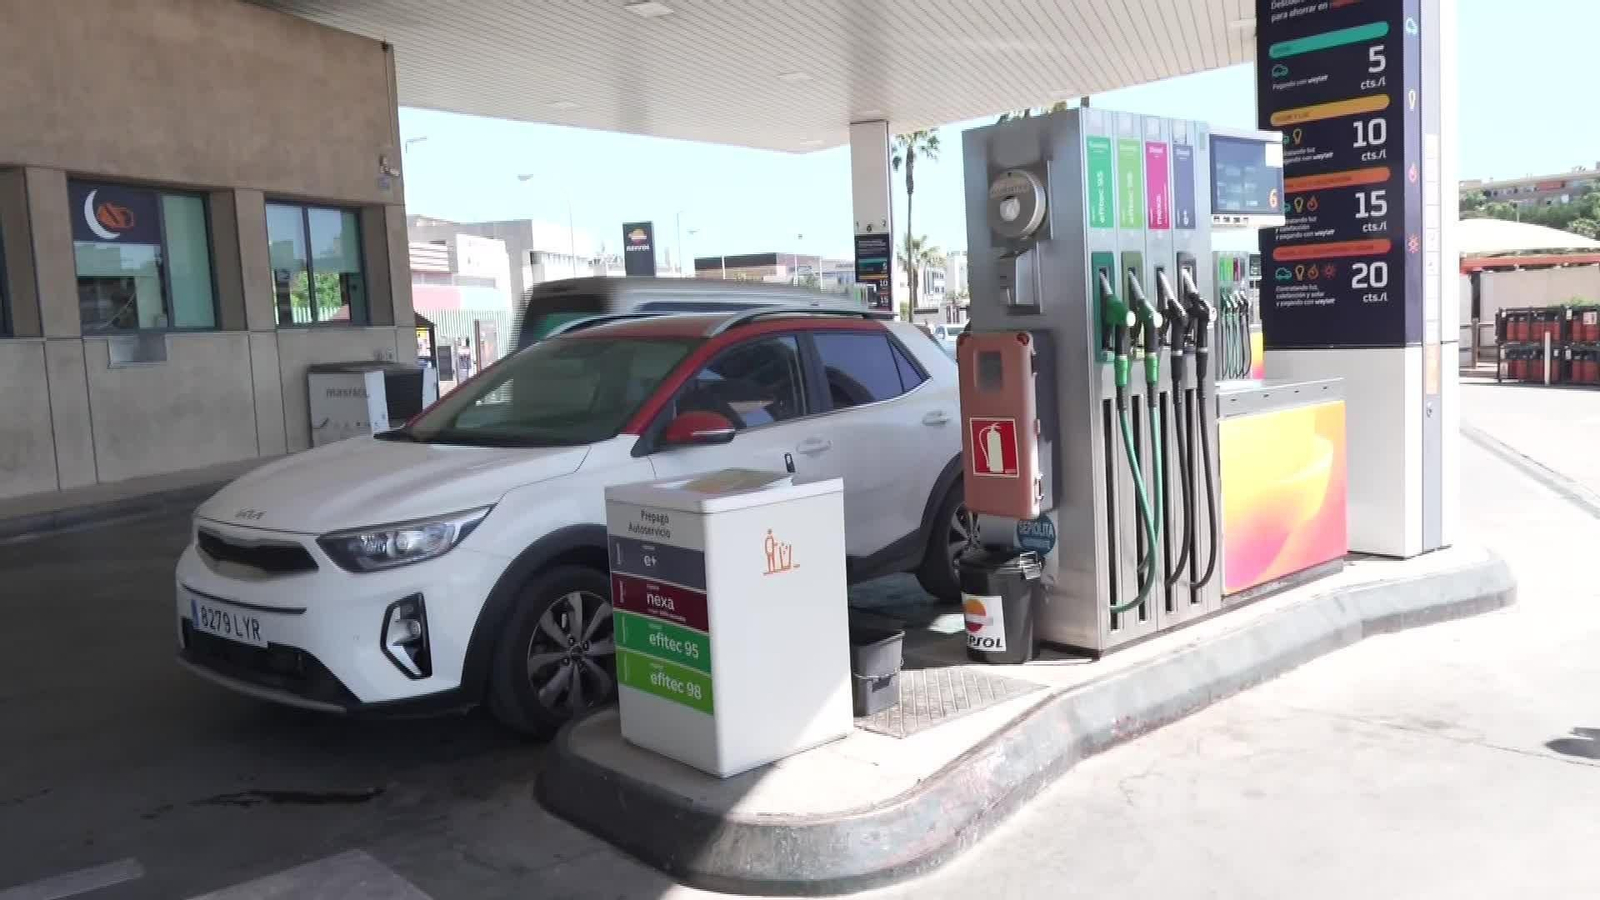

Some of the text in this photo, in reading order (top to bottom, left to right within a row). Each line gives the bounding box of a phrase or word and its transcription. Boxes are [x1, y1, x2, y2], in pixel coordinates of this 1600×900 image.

[1368, 45, 1386, 74] 5
[1360, 77, 1386, 90] cts./l
[1353, 118, 1387, 148] 10
[1361, 149, 1387, 161] cts./l
[1355, 190, 1387, 218] 15
[1362, 221, 1387, 233] cts./l
[1351, 262, 1388, 289] 20
[1362, 292, 1388, 303] cts./l
[640, 509, 670, 526] Prepago
[628, 521, 671, 539] Autoservicio
[646, 593, 675, 611] nexa
[201, 606, 261, 641] 8279 LYR
[649, 633, 700, 660] efitec 95
[650, 673, 702, 701] efitec 98
